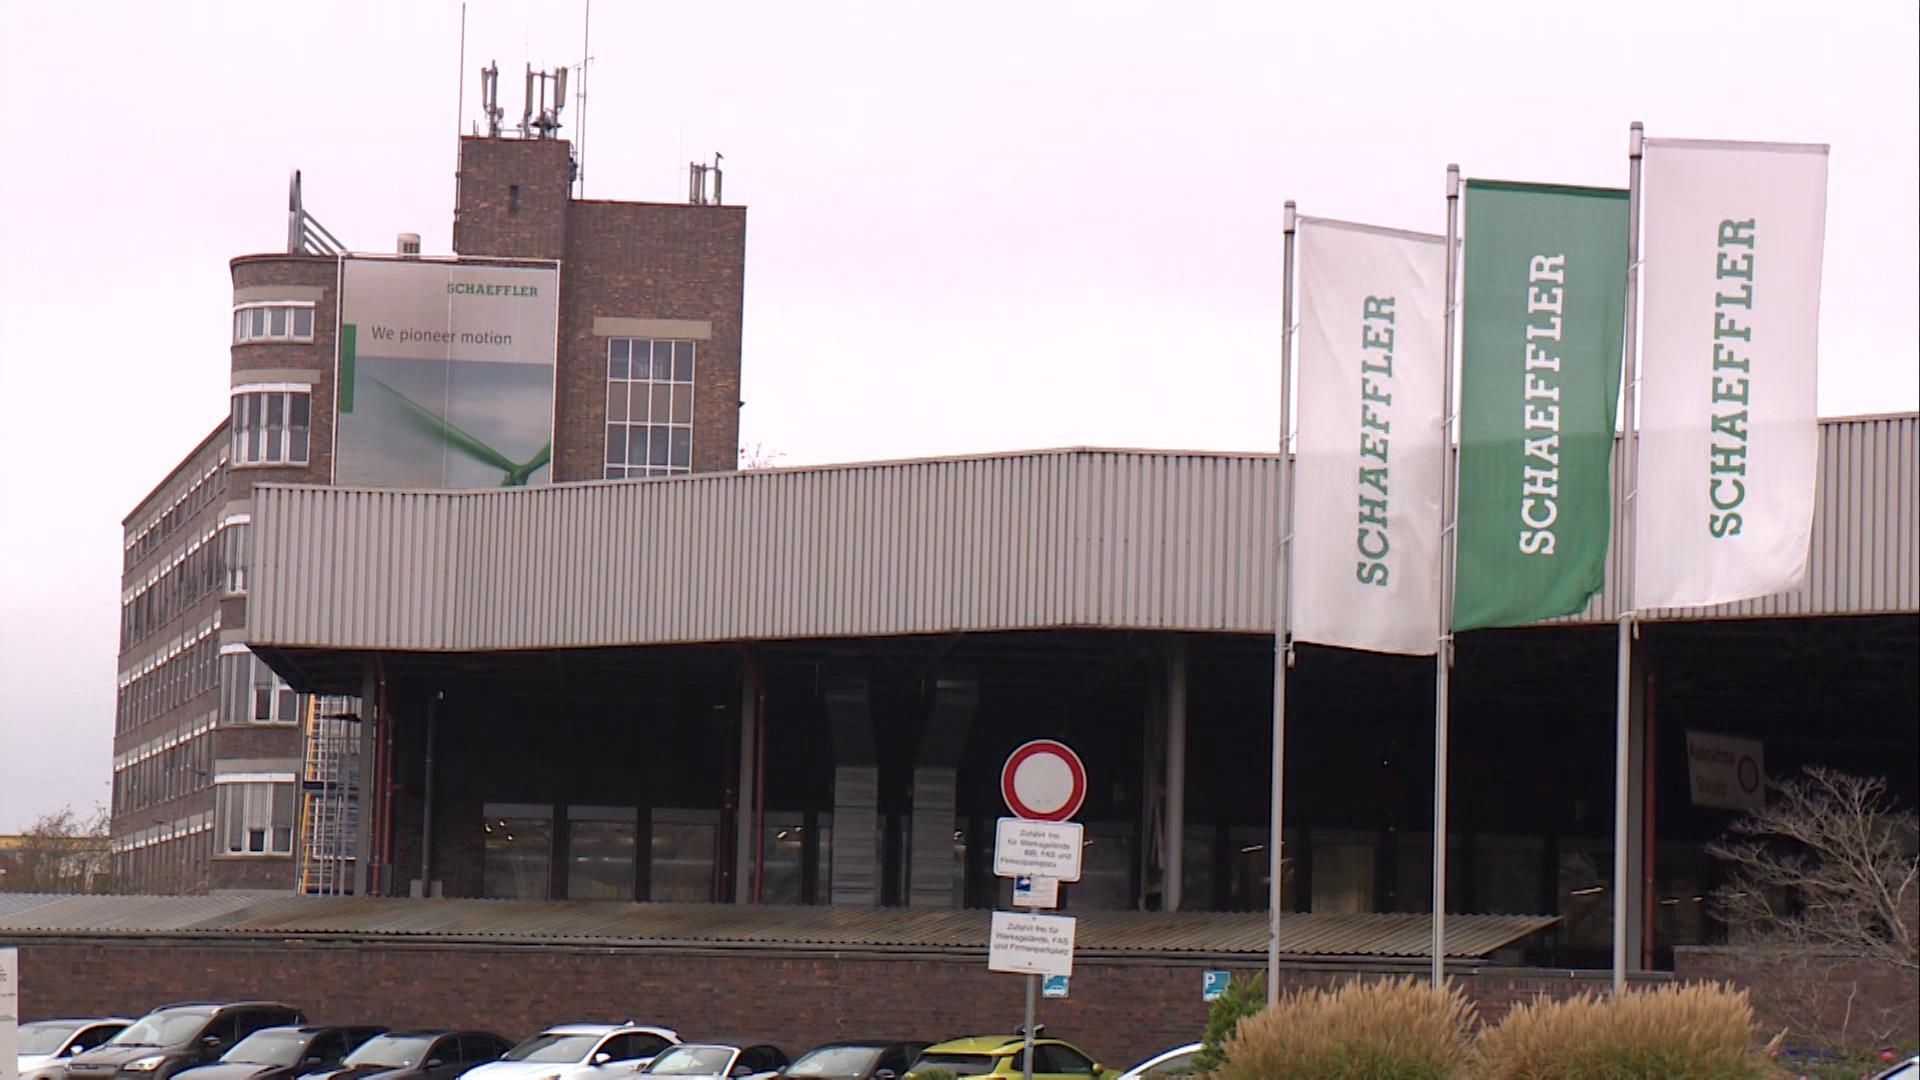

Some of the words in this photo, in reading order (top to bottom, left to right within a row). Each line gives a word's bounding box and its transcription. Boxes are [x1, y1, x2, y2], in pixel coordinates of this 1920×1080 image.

[447, 284, 538, 297] SCHAEFFLER
[372, 326, 394, 341] We
[399, 328, 456, 343] pioneer
[460, 332, 512, 346] motion
[1707, 218, 1756, 538] SCHAEFFLER
[1519, 253, 1565, 555] SCHAEFFLER
[1356, 294, 1396, 586] SCHAEFFLER
[1019, 829, 1046, 838] Zufahrt
[1006, 923, 1033, 931] Zufahrt
[994, 943, 1008, 951] und
[1205, 973, 1216, 989] P
